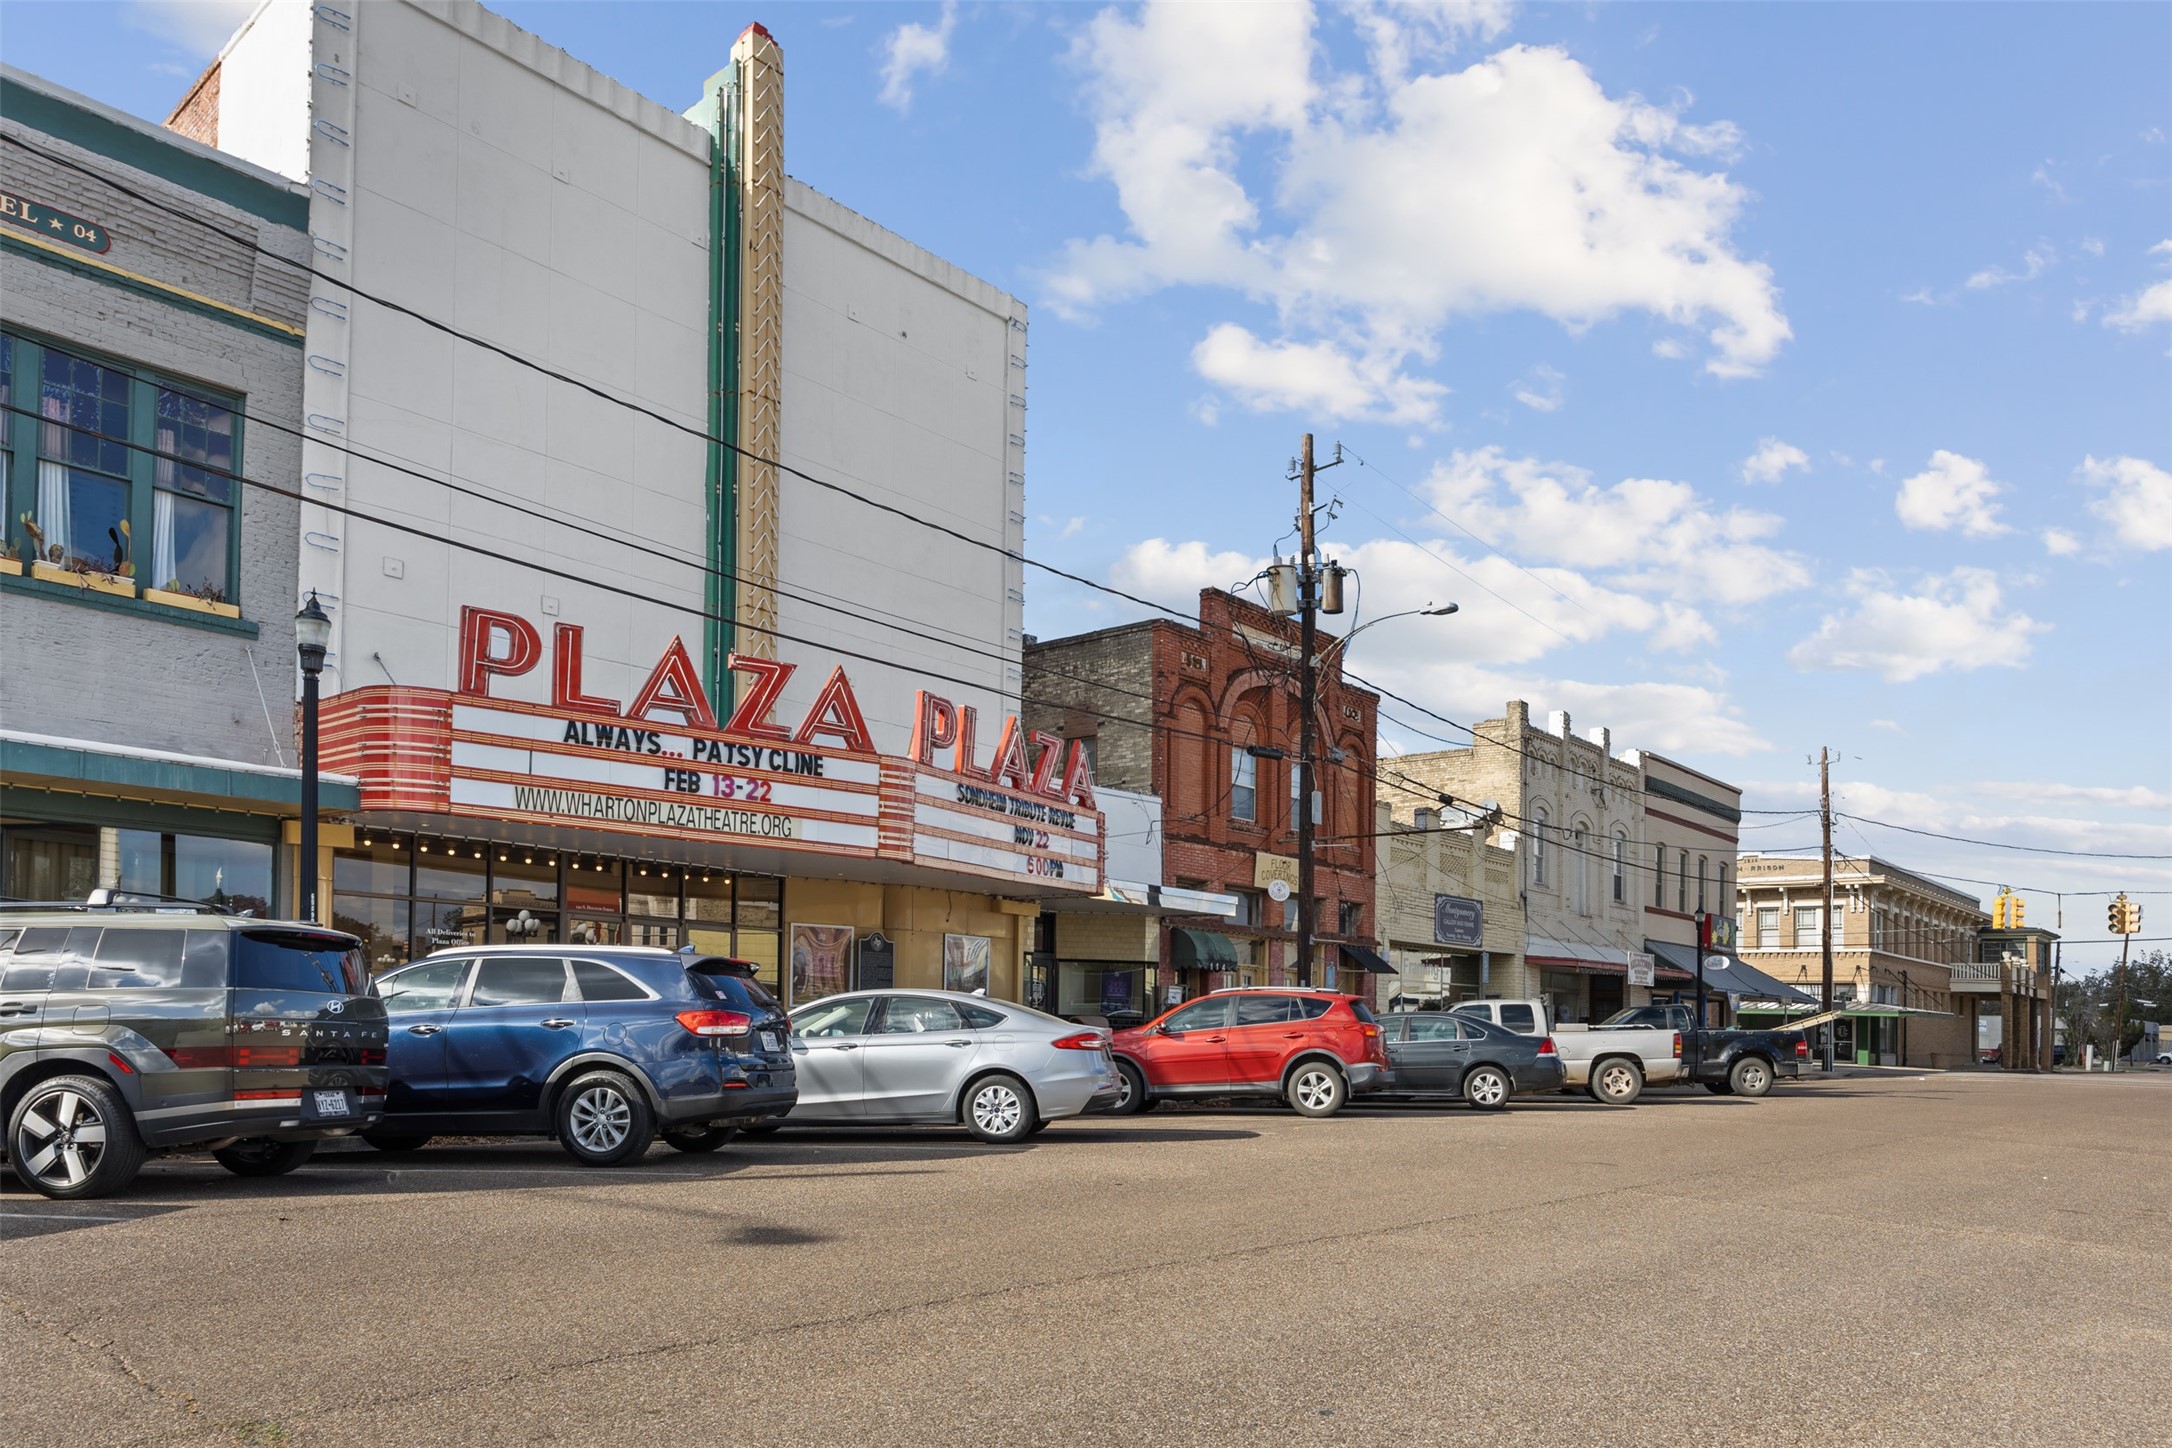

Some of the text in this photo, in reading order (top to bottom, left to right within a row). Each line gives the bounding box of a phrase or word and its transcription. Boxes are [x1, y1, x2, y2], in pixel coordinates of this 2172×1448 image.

[73, 224, 97, 243] 04
[459, 604, 877, 754] PLAZA
[563, 720, 824, 777] ALWAYS... PATSY CLINE
[913, 689, 1097, 810] PLAZA
[664, 767, 772, 802] FEB 13-22
[514, 785, 792, 838] WWW.WHARTONPLAZATHEATRE.ORG
[957, 783, 1075, 829] SONDHEIM TRIBUTE REVUE
[1015, 825, 1049, 849] NOV 22
[1271, 859, 1292, 871] FLOOR
[1261, 870, 1298, 886] COVERINGS
[1442, 903, 1476, 921] Montgomery
[431, 937, 450, 945] Plaza
[437, 928, 468, 937] Deliveries
[1403, 958, 1440, 980] Framing
[281, 1029, 351, 1038] SANTA
